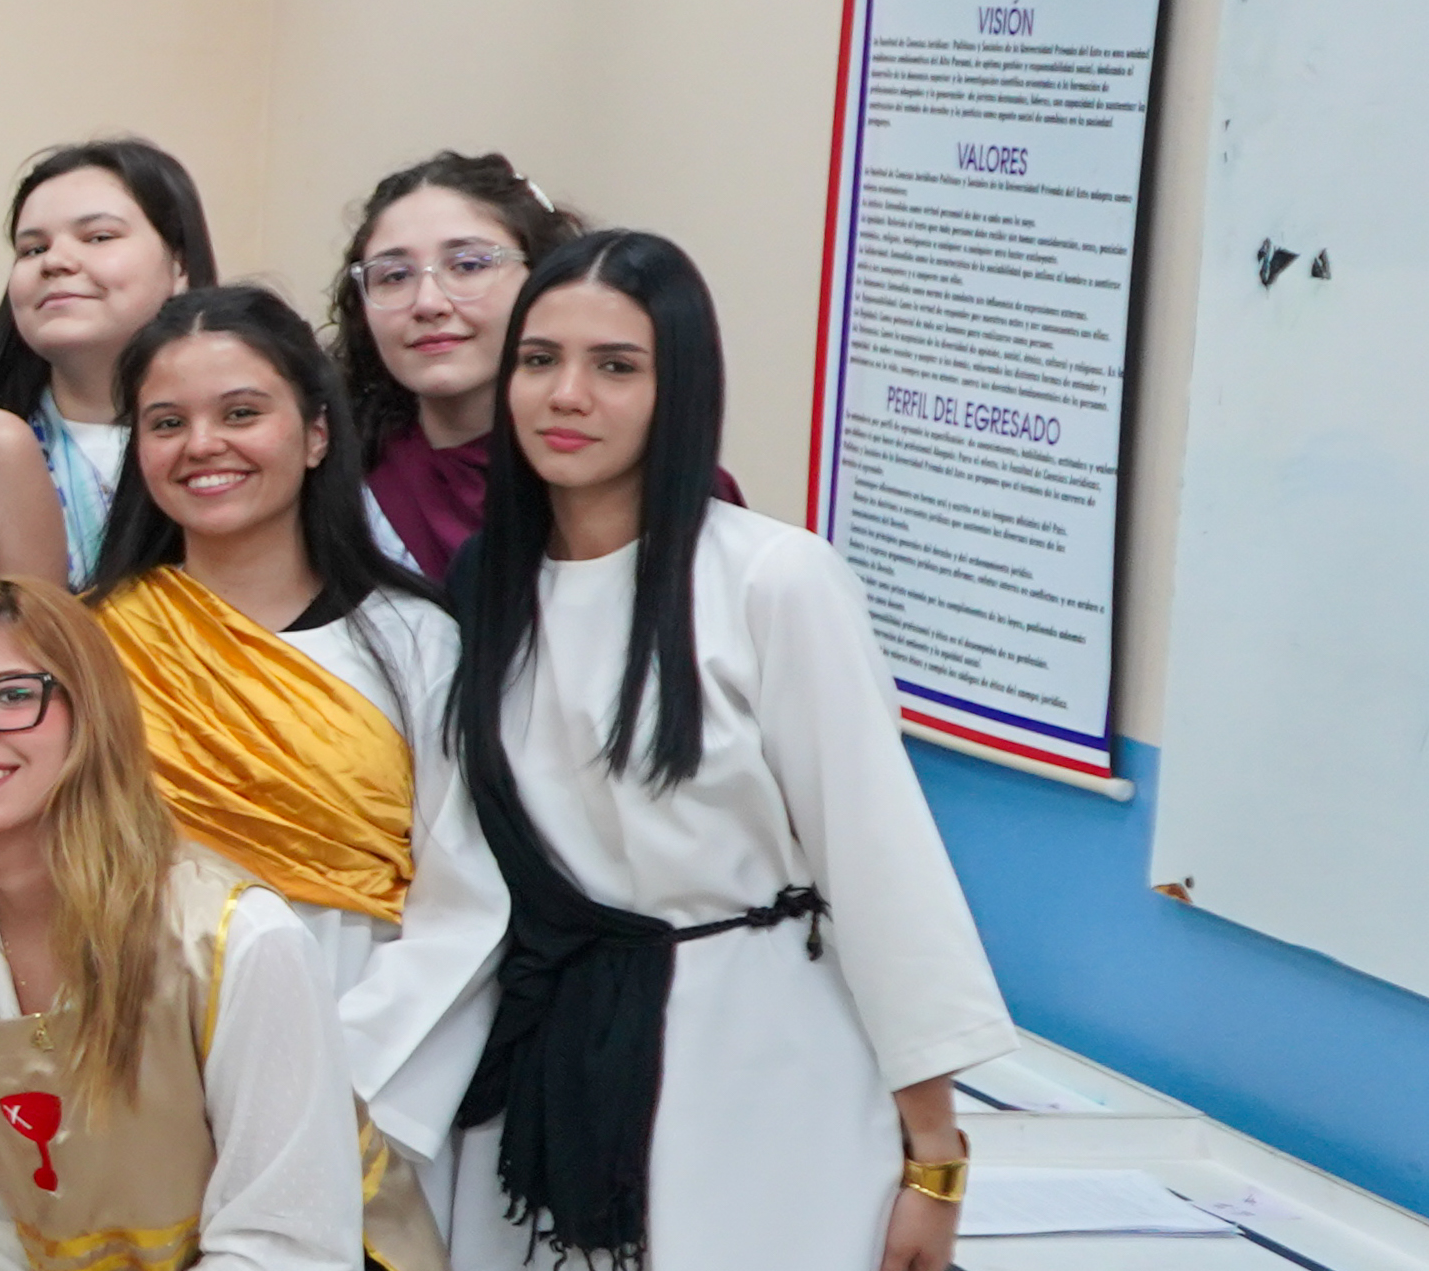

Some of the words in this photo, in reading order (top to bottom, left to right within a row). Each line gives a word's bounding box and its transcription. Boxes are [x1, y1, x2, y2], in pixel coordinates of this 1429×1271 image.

[978, 0, 1035, 36] VISIÓN
[957, 141, 1029, 176] VALORES
[886, 386, 929, 421] PERFIL
[933, 396, 959, 428] DEL
[965, 403, 1062, 446] EGRESADO
